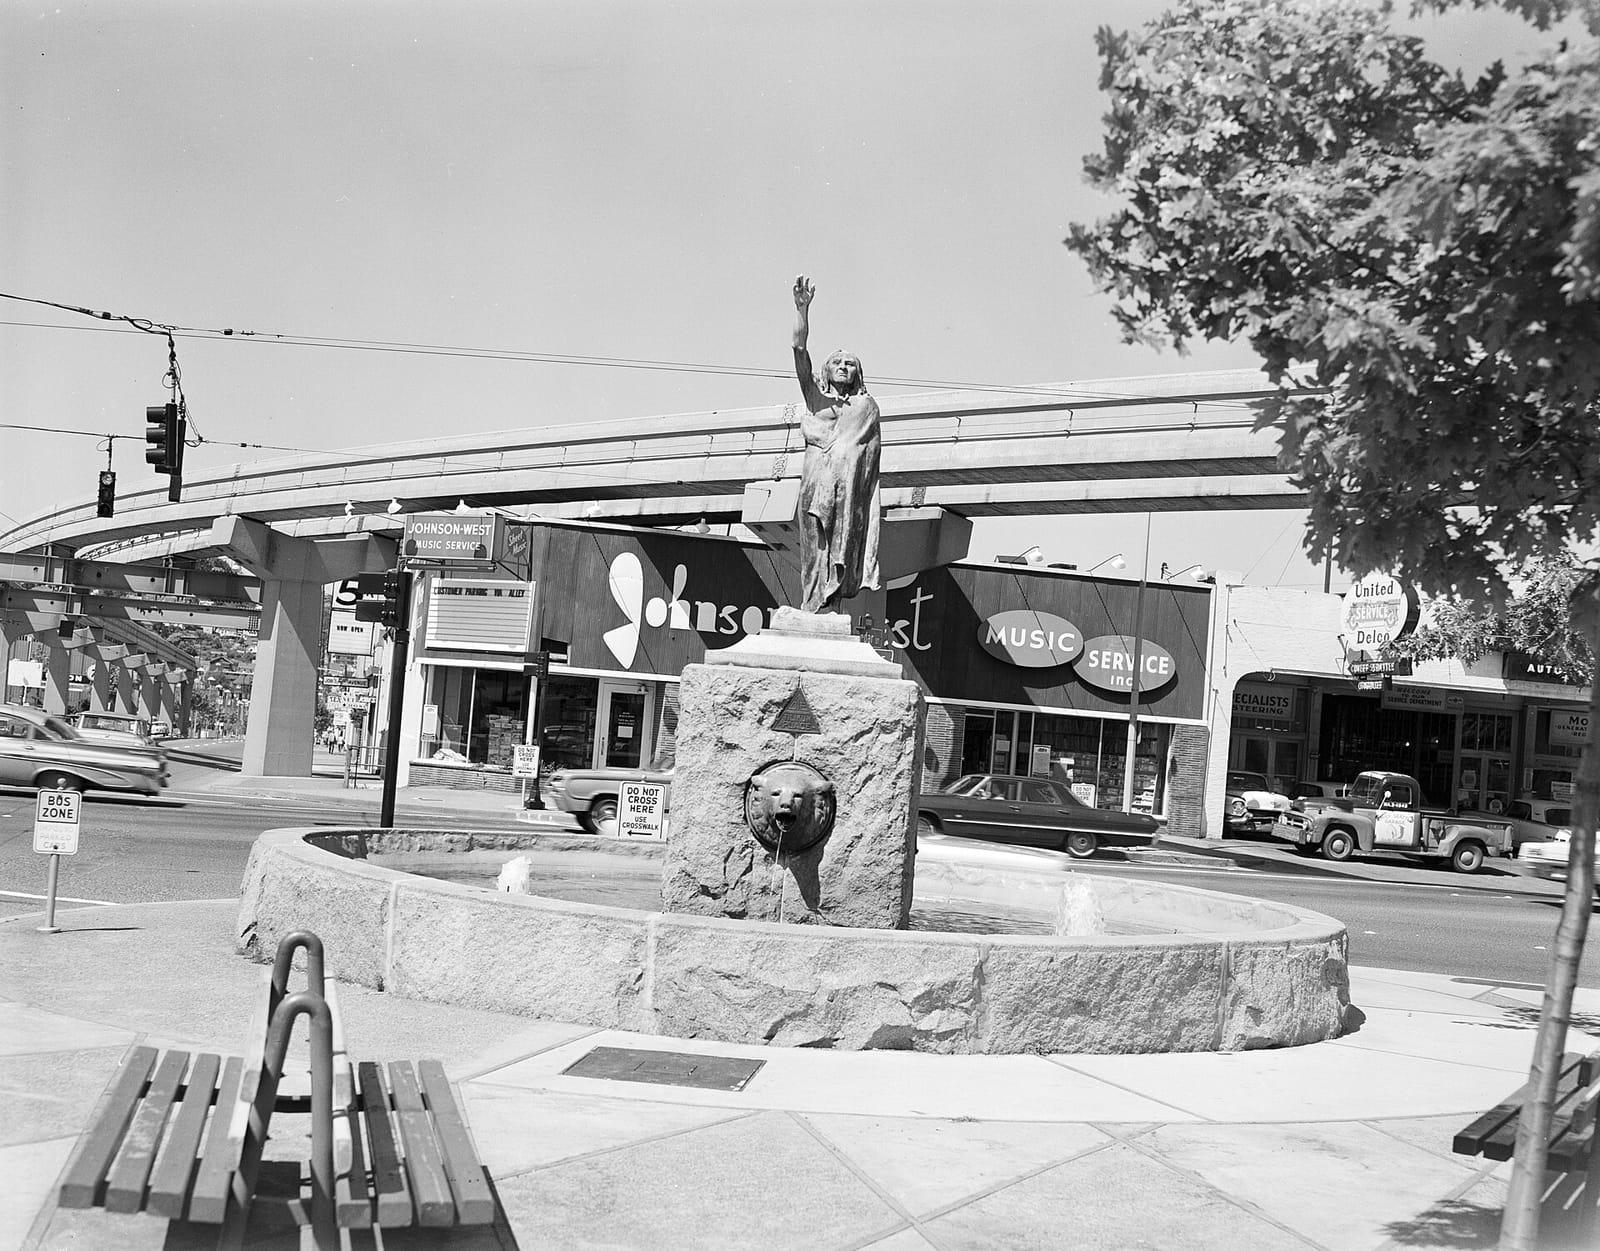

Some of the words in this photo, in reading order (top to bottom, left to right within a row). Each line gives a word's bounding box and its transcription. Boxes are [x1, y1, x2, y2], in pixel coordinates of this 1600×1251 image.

[408, 522, 492, 536] JOHNSON-WEST
[415, 539, 443, 549] MUSIC
[445, 540, 481, 551] SERVICE
[433, 587, 463, 596] CUSTOMER
[465, 587, 488, 597] PARKING
[1355, 580, 1394, 598] United
[985, 624, 1075, 652] MUSIC
[1357, 629, 1390, 644] Delco
[1088, 649, 1169, 675] SERVICE
[1397, 687, 1432, 695] WELCOME
[1387, 696, 1409, 704] SERVICE
[1409, 697, 1442, 707] DEPARTMENT
[627, 786, 640, 795] DO
[642, 786, 660, 797] NOT
[48, 795, 71, 807] BUS
[627, 795, 658, 805] CROSS
[42, 807, 74, 819] ZONE
[629, 804, 655, 814] HERE
[634, 816, 648, 824] USE
[621, 821, 659, 831] CROSSWALK
